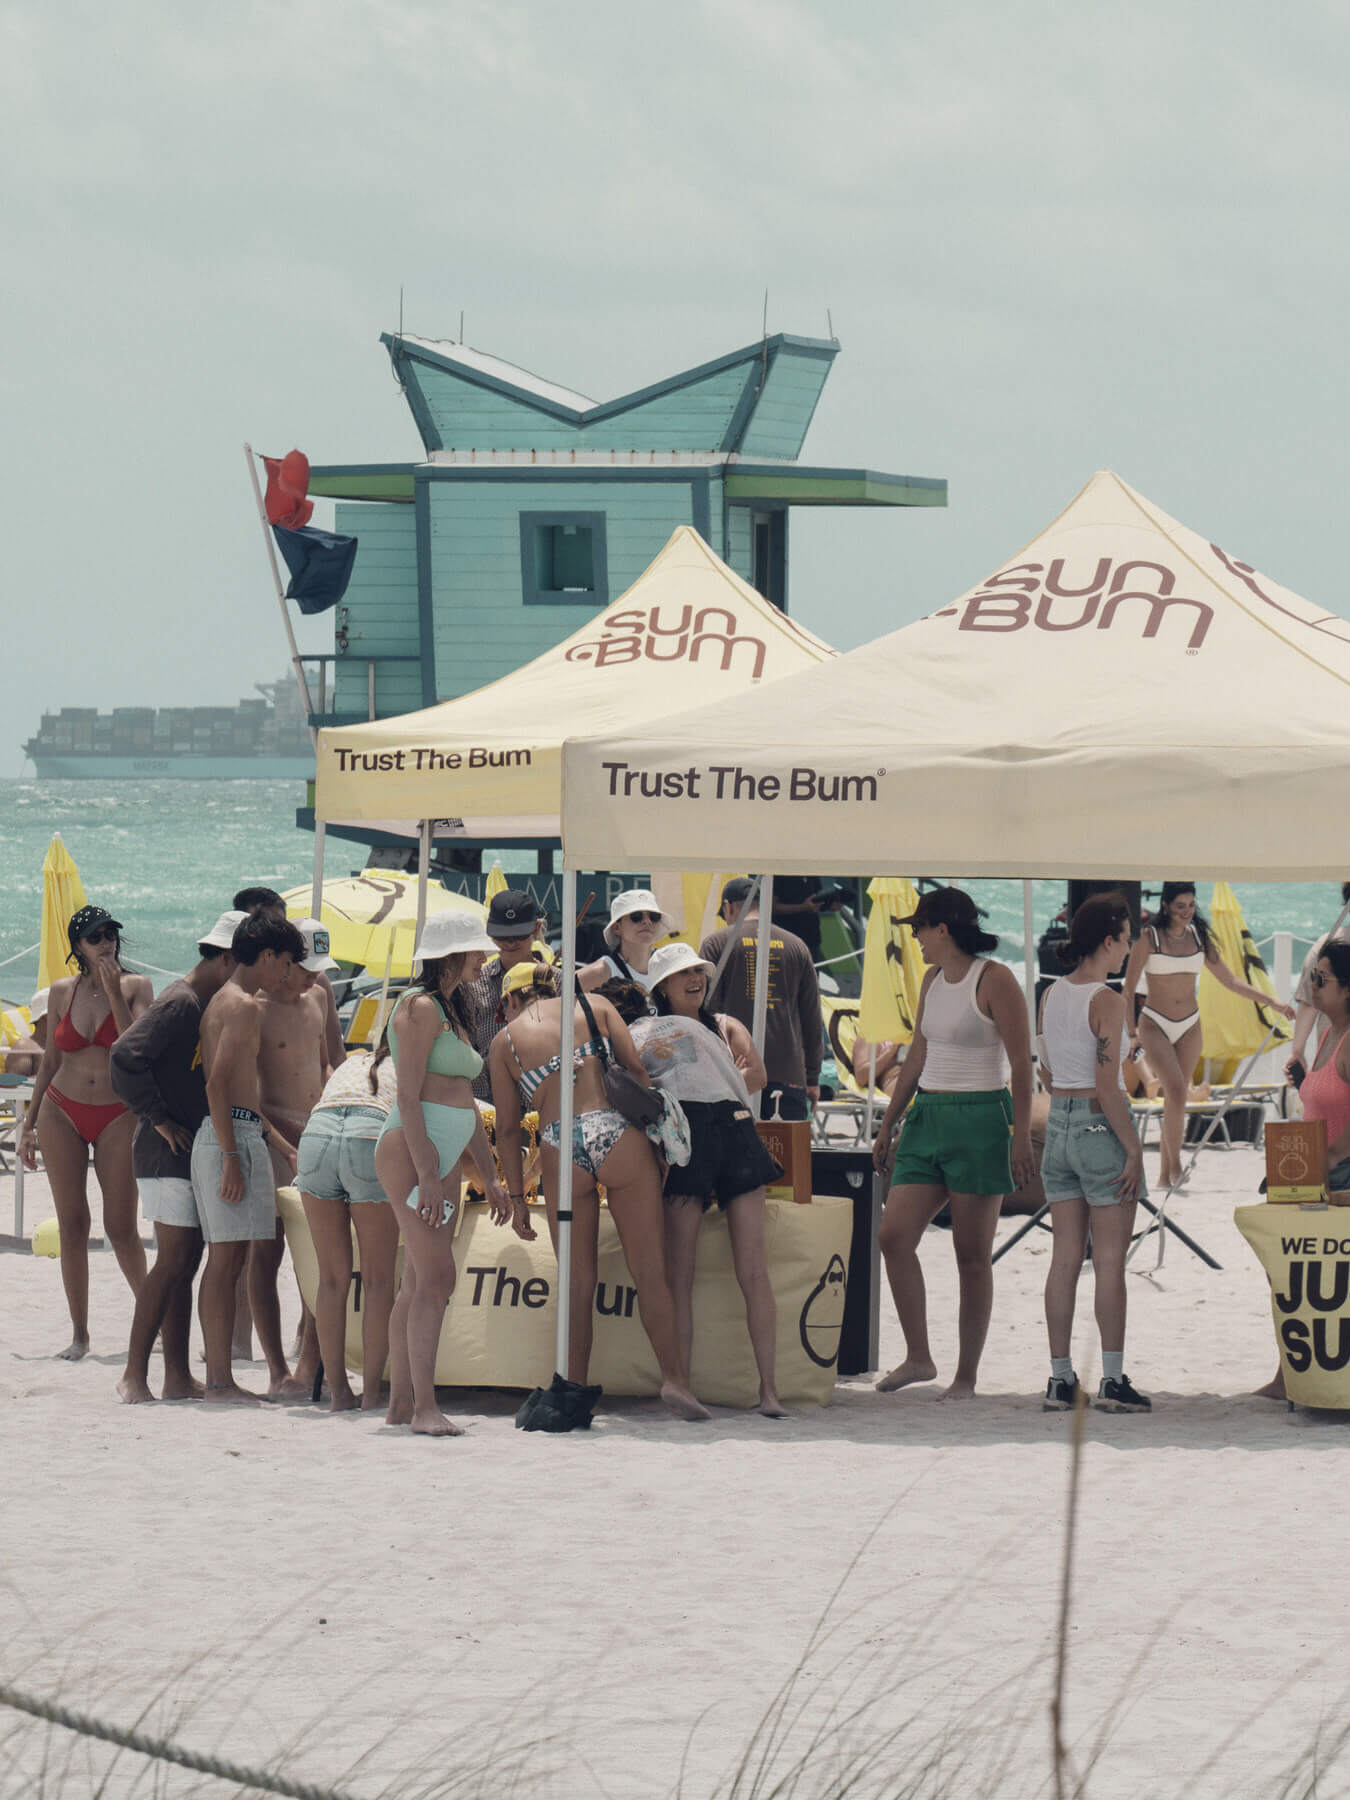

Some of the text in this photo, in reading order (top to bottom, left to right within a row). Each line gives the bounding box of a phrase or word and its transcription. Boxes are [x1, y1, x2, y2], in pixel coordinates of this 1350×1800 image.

[334, 747, 532, 772] Trust The Bum
[601, 761, 701, 799] Trust
[708, 766, 781, 800] The
[1280, 1236, 1318, 1256] WE
[466, 1266, 550, 1309] The
